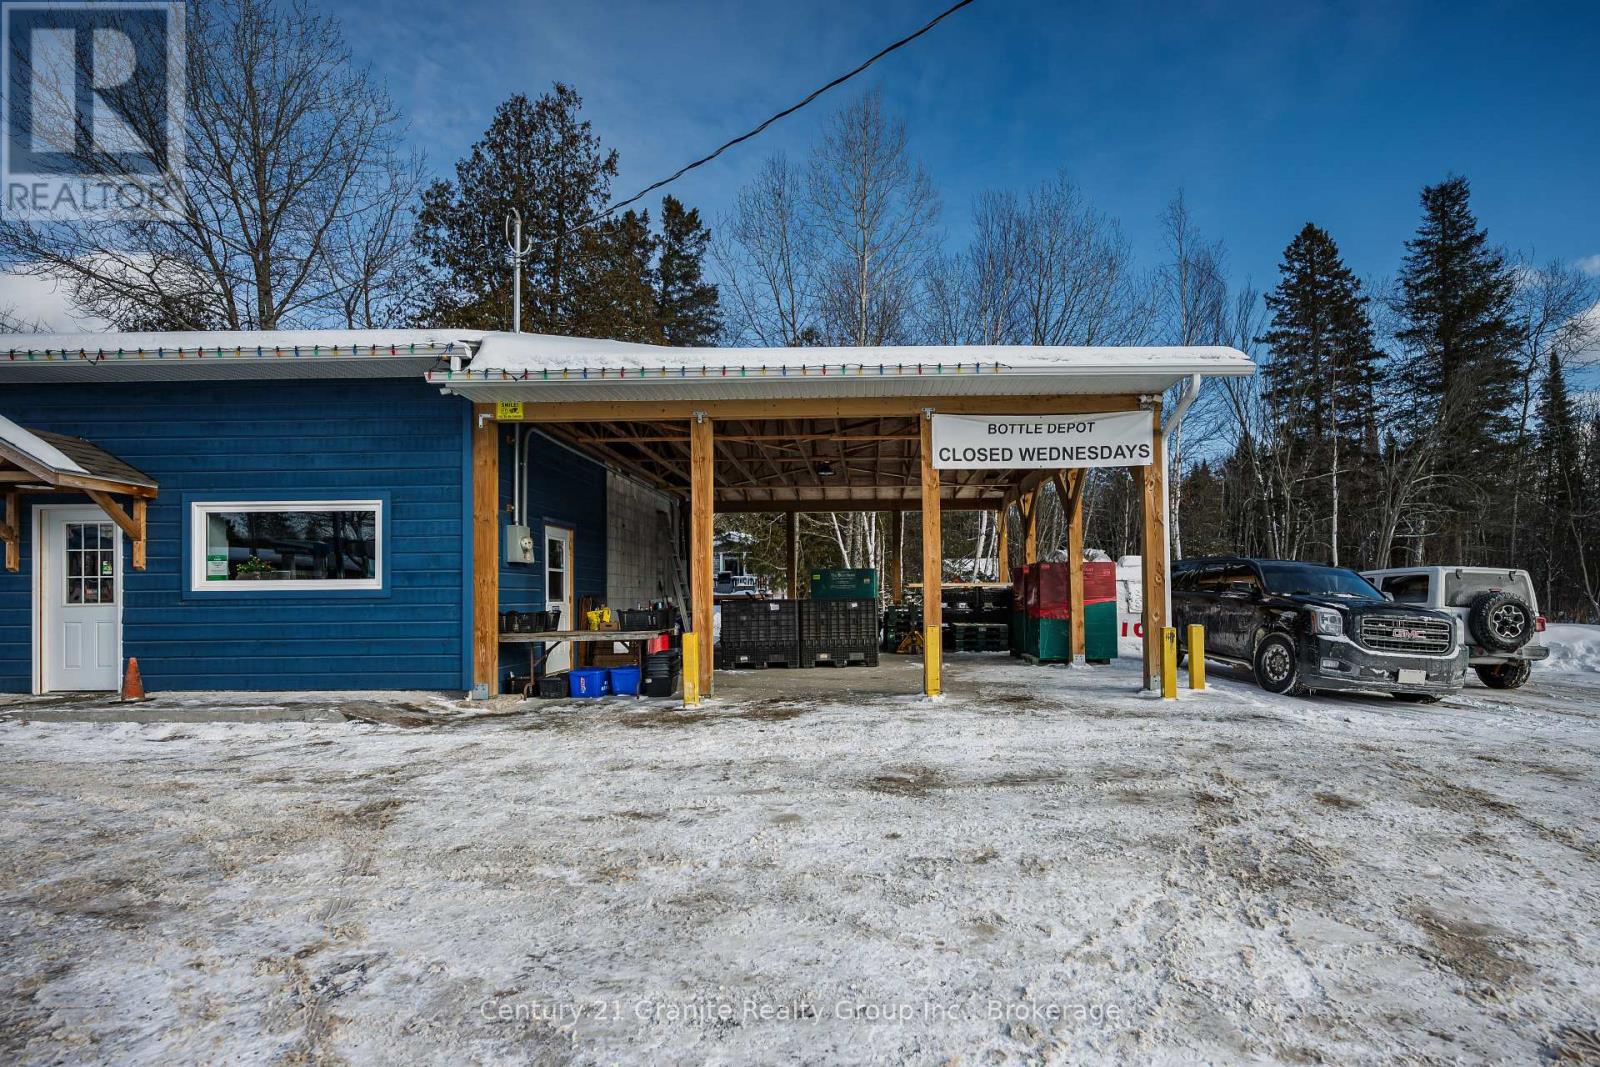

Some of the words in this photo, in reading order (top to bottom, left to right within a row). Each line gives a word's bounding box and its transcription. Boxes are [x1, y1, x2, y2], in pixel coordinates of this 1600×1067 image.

[987, 423, 1043, 435] BOTTLE
[1047, 422, 1095, 434] DEPOT
[938, 447, 1014, 463] CLOSED
[1018, 444, 1150, 462] WEDNESDAYS
[1392, 629, 1427, 639] GMC
